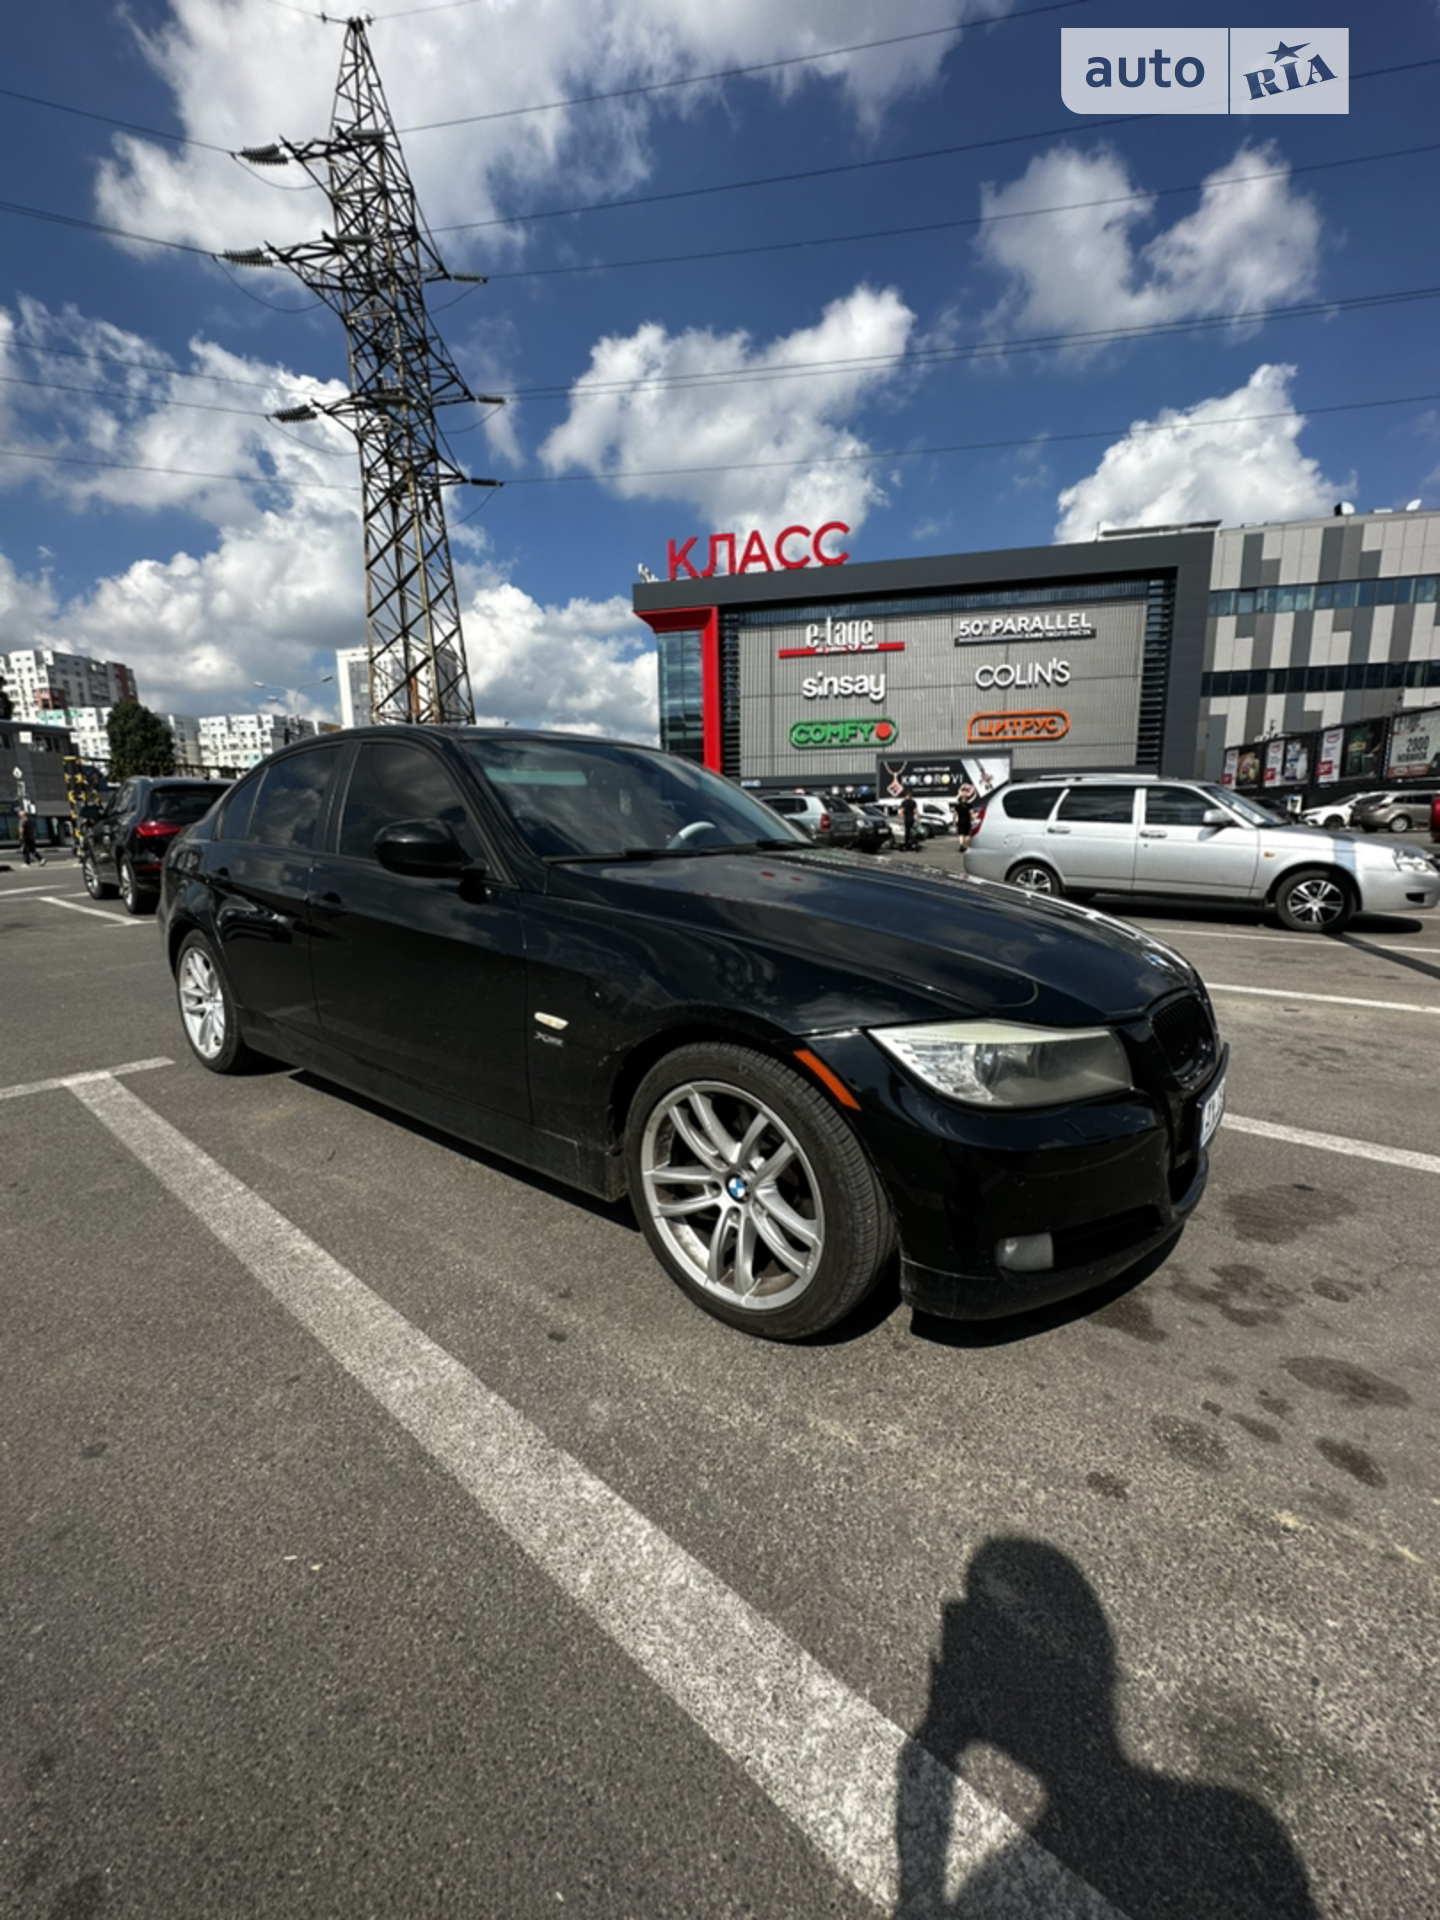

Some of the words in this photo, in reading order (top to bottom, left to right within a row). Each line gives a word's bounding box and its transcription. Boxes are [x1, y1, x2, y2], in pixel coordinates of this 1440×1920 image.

[667, 521, 849, 580] КЛАСС
[806, 616, 874, 650] e-tage
[991, 612, 1092, 634] PARALLEL
[802, 671, 886, 701] sinsay
[975, 657, 1070, 686] COLIN'S
[793, 723, 874, 742] COMFY
[977, 717, 1058, 736] ЦИТРУС
